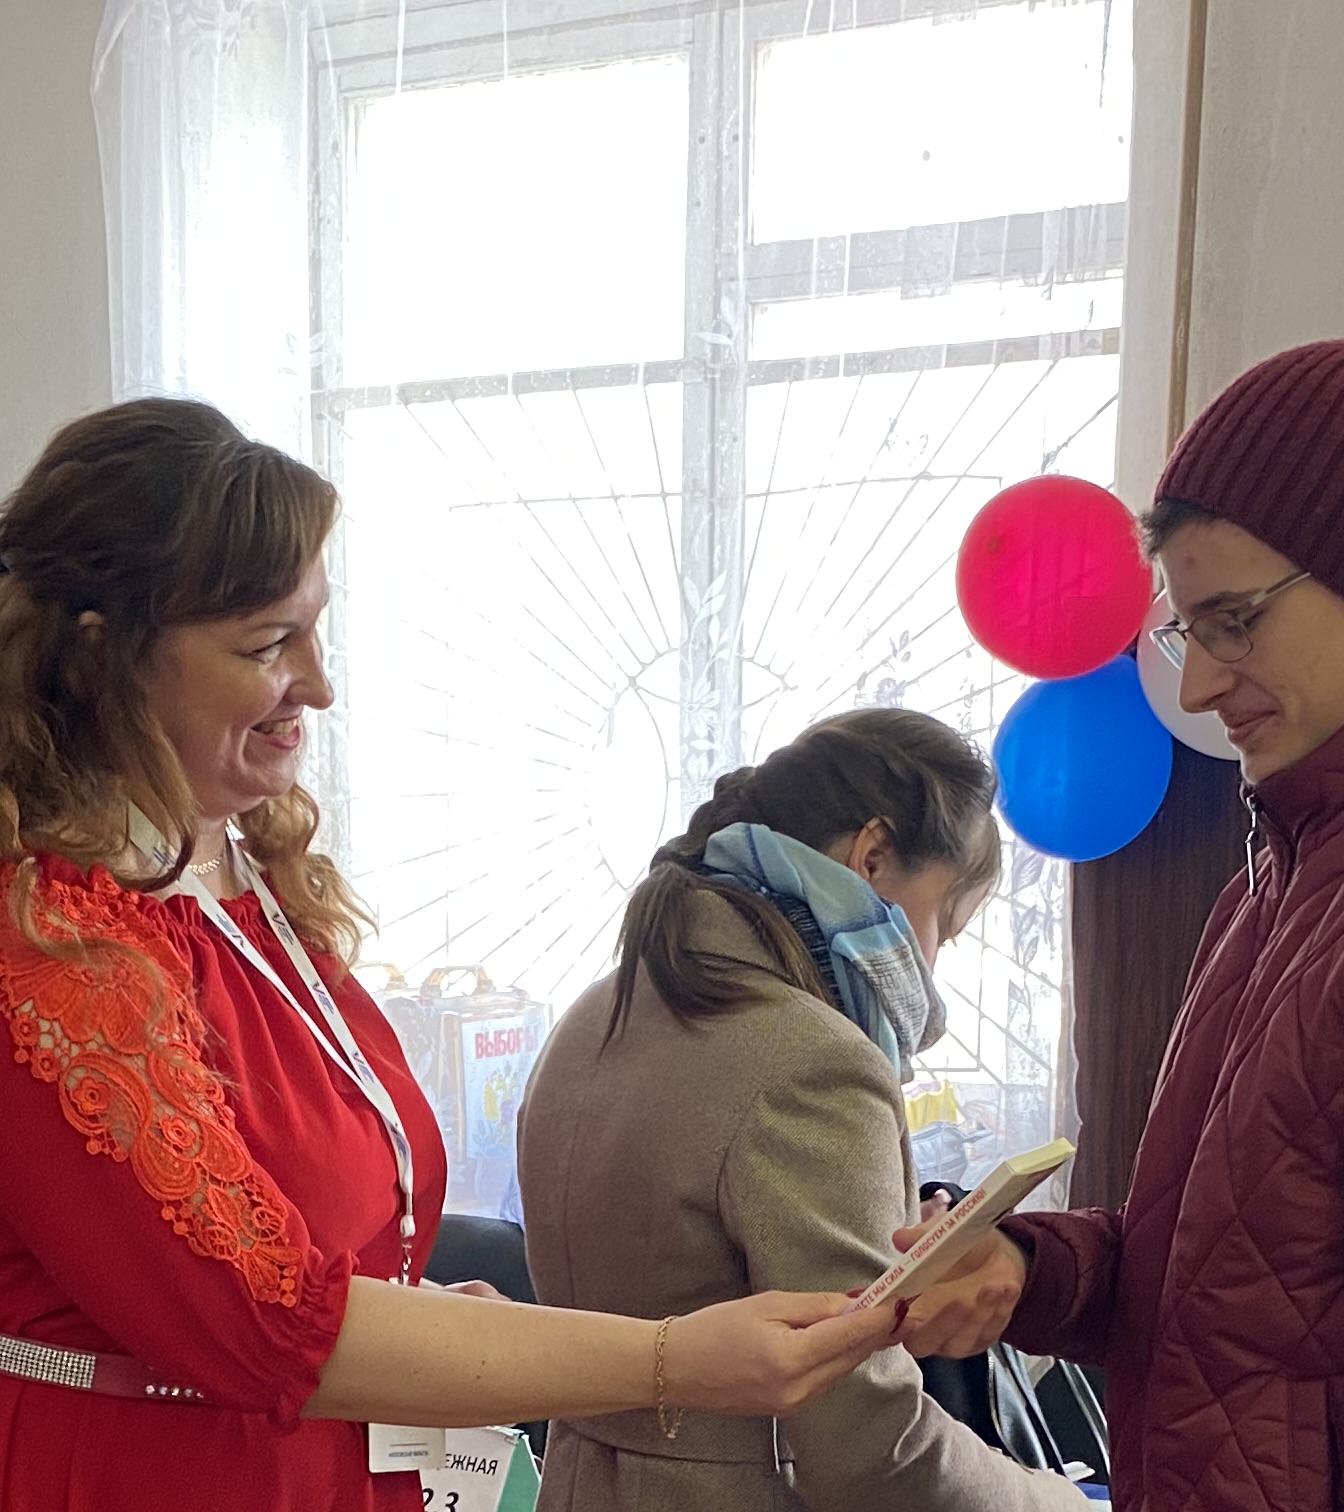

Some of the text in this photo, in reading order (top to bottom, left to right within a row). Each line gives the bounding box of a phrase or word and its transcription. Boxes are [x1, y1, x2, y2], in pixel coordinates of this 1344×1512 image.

[851, 1292, 876, 1312] ЕСТЕ
[871, 1281, 888, 1298] МЫ
[884, 1264, 906, 1286] СИЛА
[910, 1224, 947, 1262] ГОЛОСУЕМ
[944, 1217, 958, 1230] ЗА
[954, 1186, 987, 1221] РОССИЮ!
[442, 1452, 499, 1477] ЕЖНАЯ
